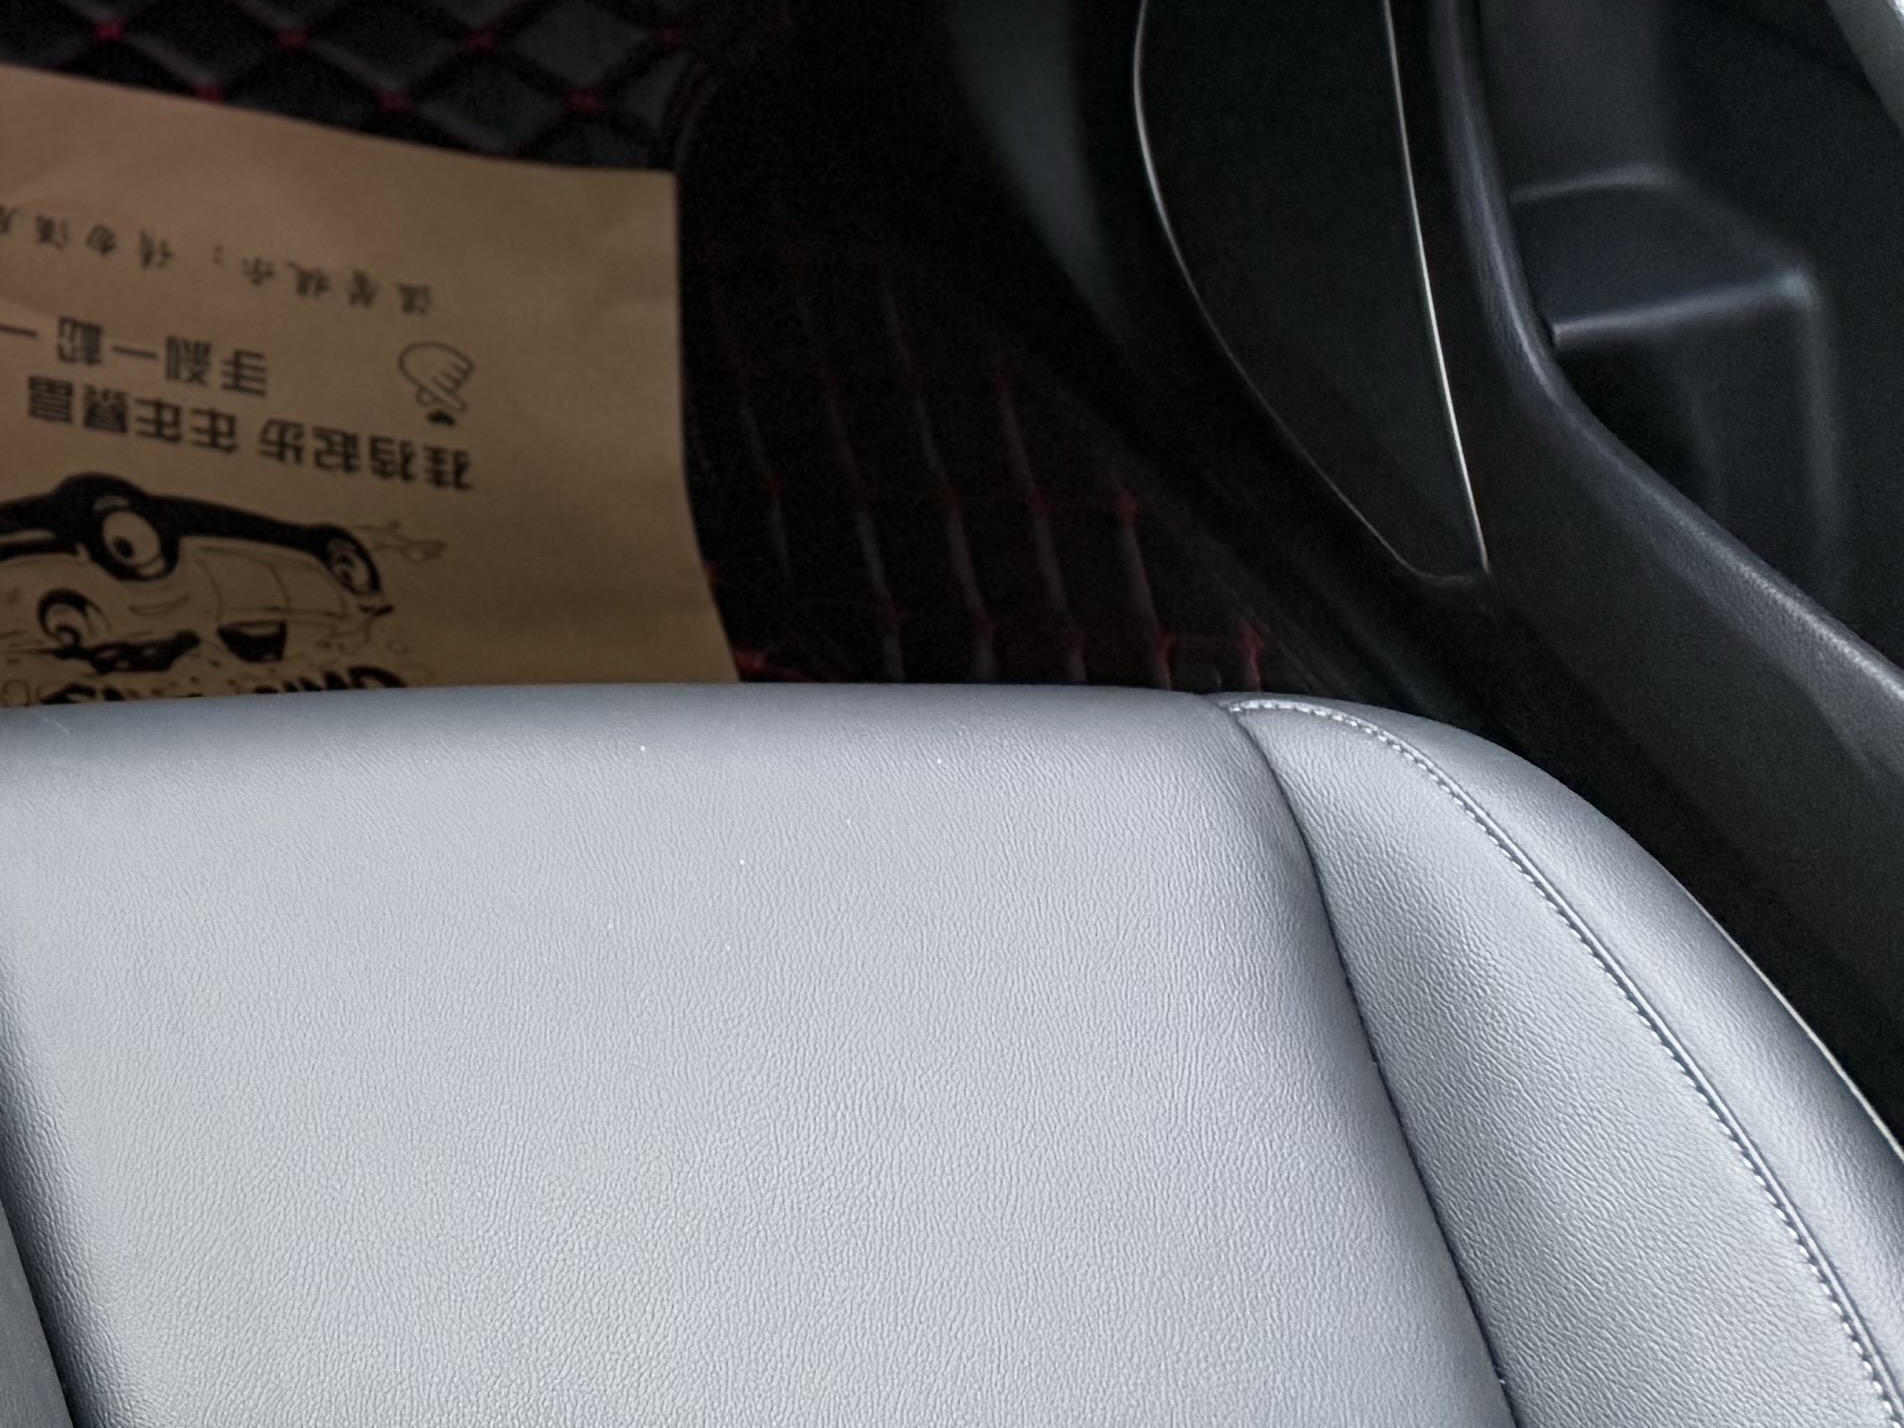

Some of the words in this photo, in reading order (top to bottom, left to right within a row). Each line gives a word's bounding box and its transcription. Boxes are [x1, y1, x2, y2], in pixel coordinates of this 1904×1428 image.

[57, 315, 269, 398] 手刹一松
[27, 374, 239, 455] 年年暴富
[258, 417, 476, 491] 挂挡起步
